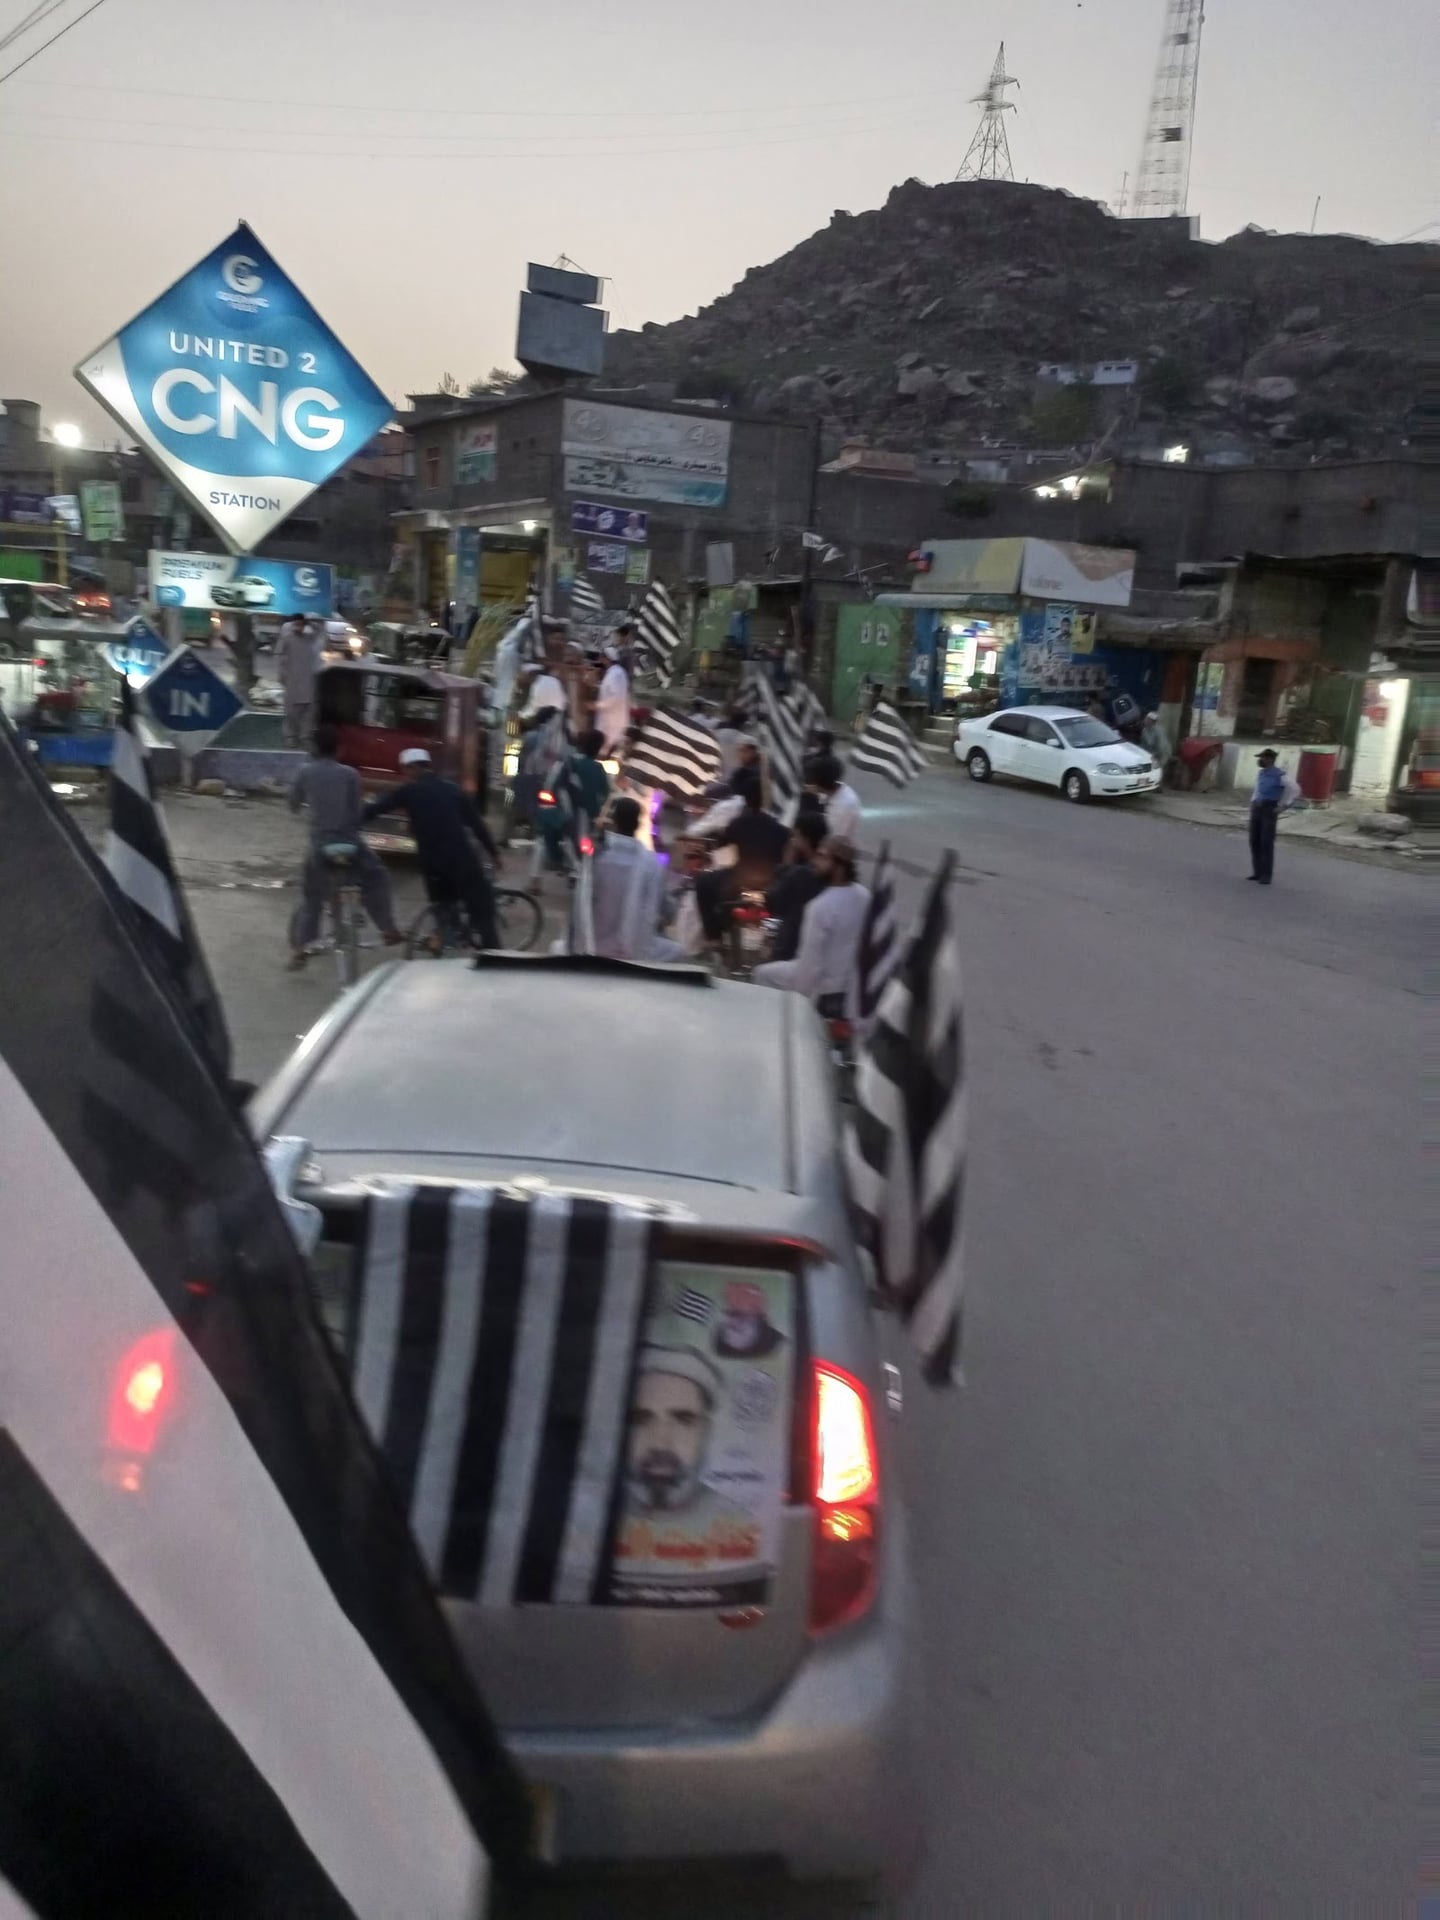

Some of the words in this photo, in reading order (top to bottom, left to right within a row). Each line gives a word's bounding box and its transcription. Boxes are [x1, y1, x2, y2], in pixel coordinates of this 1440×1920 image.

[169, 331, 289, 368] UNITED
[299, 352, 317, 374] 2
[152, 367, 345, 451] CNG
[209, 491, 281, 511] STATION
[161, 568, 204, 580] FUELS
[169, 688, 210, 717] IN
